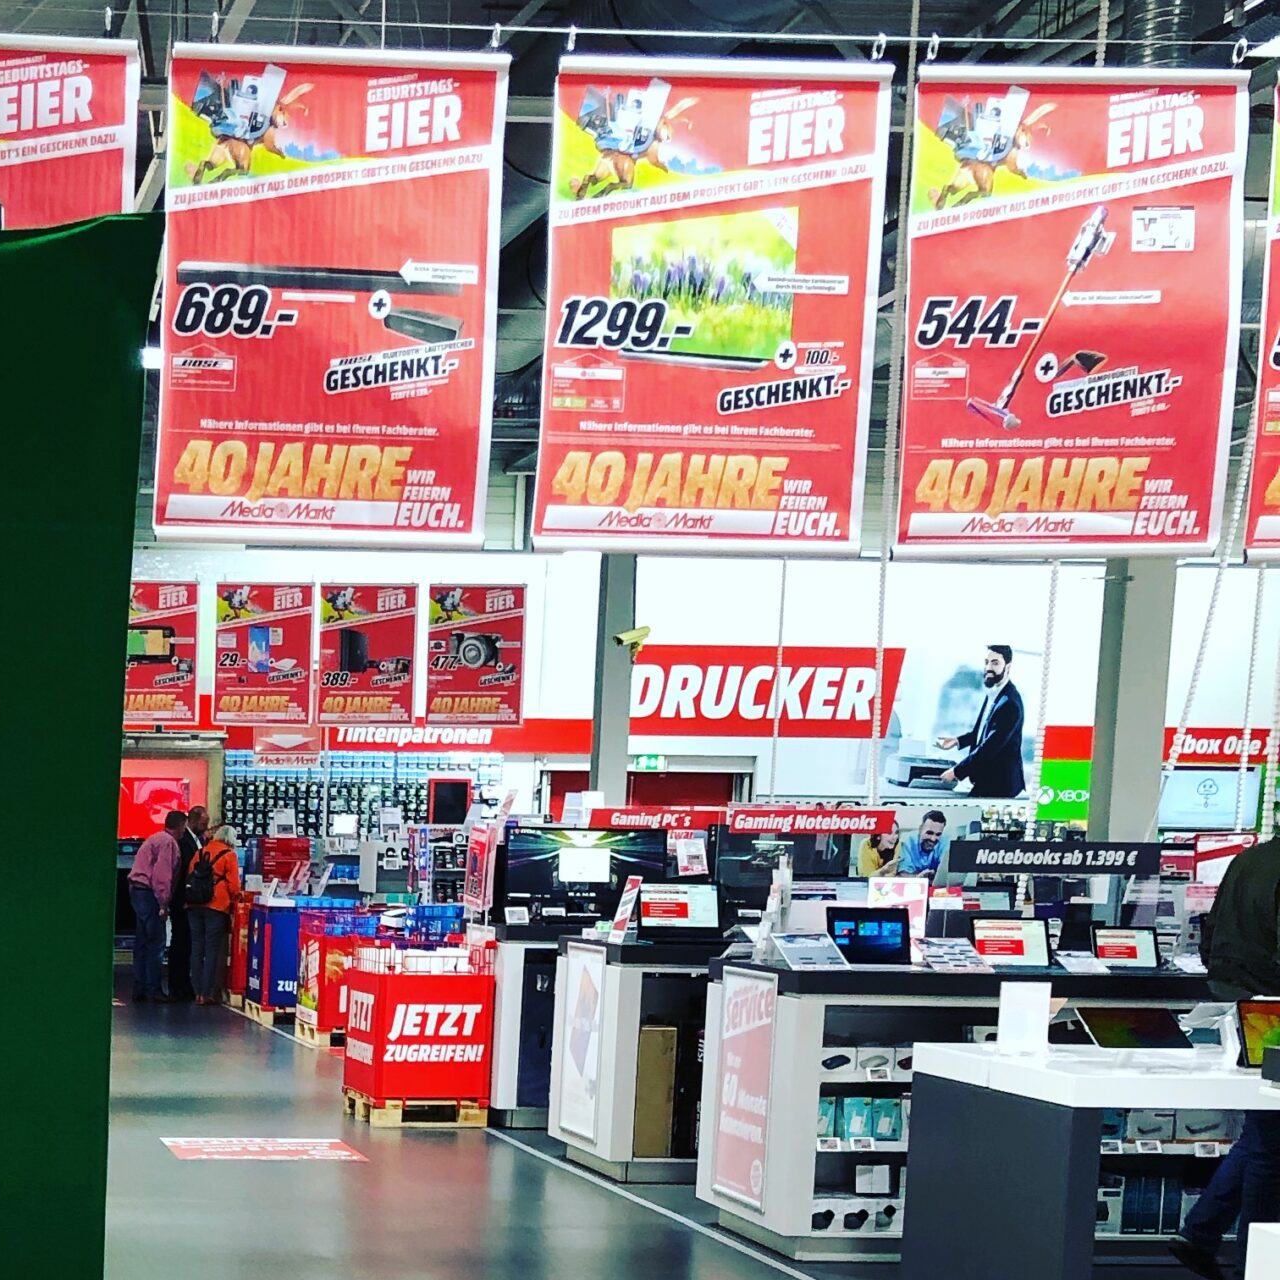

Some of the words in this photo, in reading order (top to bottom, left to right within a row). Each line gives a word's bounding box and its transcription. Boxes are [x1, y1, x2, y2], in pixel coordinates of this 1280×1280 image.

[367, 78, 460, 103] GEBURTSTAGS-
[366, 94, 462, 152] EIER
[747, 106, 845, 165] EIER
[1107, 105, 1204, 168] EIER
[174, 285, 295, 335] 689.-
[557, 299, 691, 347] 1299.-
[917, 298, 1039, 345] 544.-
[235, 420, 303, 432] Informationen
[304, 422, 323, 435] gibt
[336, 423, 351, 434] bei
[174, 439, 247, 496] 40
[243, 441, 413, 503] JAHRE
[407, 470, 435, 484] WIR
[552, 451, 626, 507] 40
[623, 451, 788, 513] JAHRE
[784, 480, 812, 494] WIR
[915, 458, 988, 515] 40
[984, 456, 1150, 519] JAHRE
[1143, 479, 1173, 493] WIR
[402, 486, 451, 501] FEIERN
[779, 496, 827, 510] FEIERN
[1139, 495, 1188, 509] FEIERN
[221, 501, 274, 519] Media
[289, 501, 336, 520] Markt
[398, 501, 464, 528] EUCH.
[598, 510, 652, 528] Media
[665, 511, 714, 529] Markt
[774, 511, 840, 536] EUCH.
[961, 516, 1014, 533] Media
[1025, 516, 1075, 533] Markt
[1135, 511, 1200, 535] EUCH.
[159, 591, 188, 608] EIER
[274, 593, 303, 610] EIER
[377, 595, 406, 611] EIER
[486, 595, 515, 612] EIER
[630, 664, 879, 720] DRUCKER
[337, 726, 492, 745] Tintenpatronen
[1056, 790, 1090, 802] XBOX
[610, 812, 660, 828] Gaming
[734, 813, 792, 832] Gaming
[794, 814, 877, 831] Notebooks
[976, 848, 1061, 866] Notebooks
[1062, 849, 1082, 866] ab
[1085, 850, 1125, 867] 1.399
[388, 1004, 482, 1041] JETZT
[383, 1044, 484, 1063] ZUGREIFEN!
